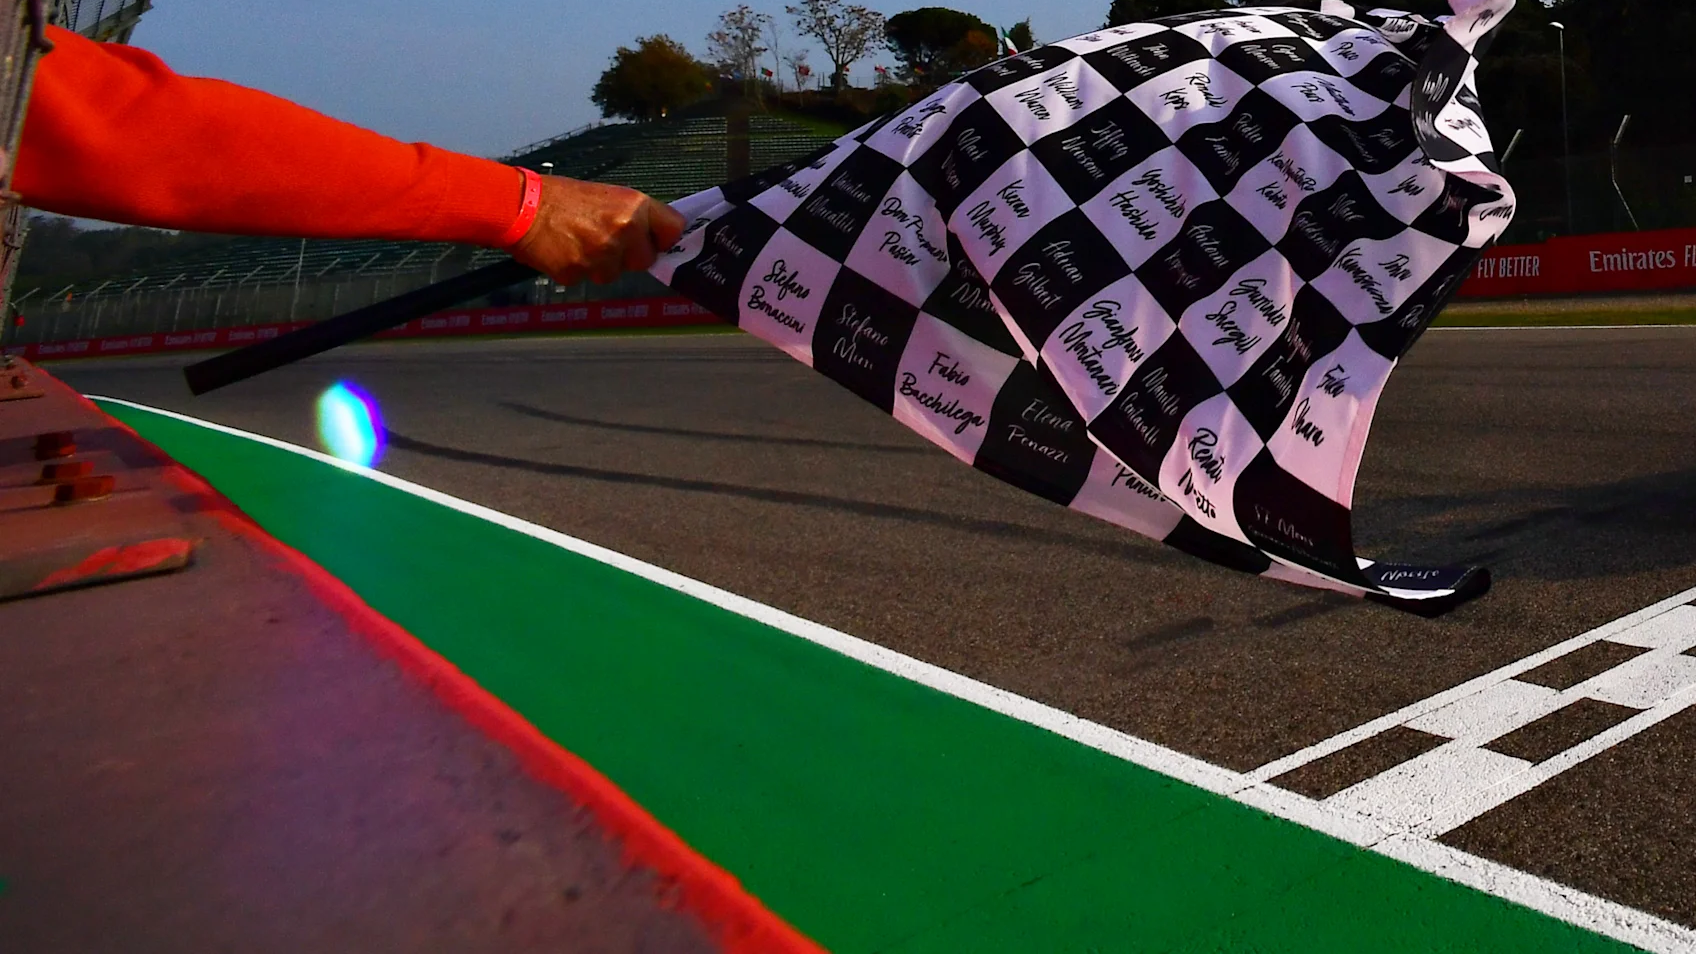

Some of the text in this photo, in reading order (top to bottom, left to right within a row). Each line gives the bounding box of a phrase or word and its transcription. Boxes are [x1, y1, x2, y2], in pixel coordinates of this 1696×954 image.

[966, 200, 1006, 257] Murphy
[763, 259, 811, 301] Stefano
[1477, 255, 1540, 279] FLY BETTER
[1589, 247, 1676, 273] Emirates
[1012, 262, 1063, 311] Gilbert
[747, 285, 806, 334] Bonaccini
[834, 303, 889, 346] Stefano
[927, 351, 972, 386] Fabio
[899, 371, 986, 435] Bacchilega
[1020, 397, 1075, 433] Elena
[1006, 424, 1070, 464] Penazzi
